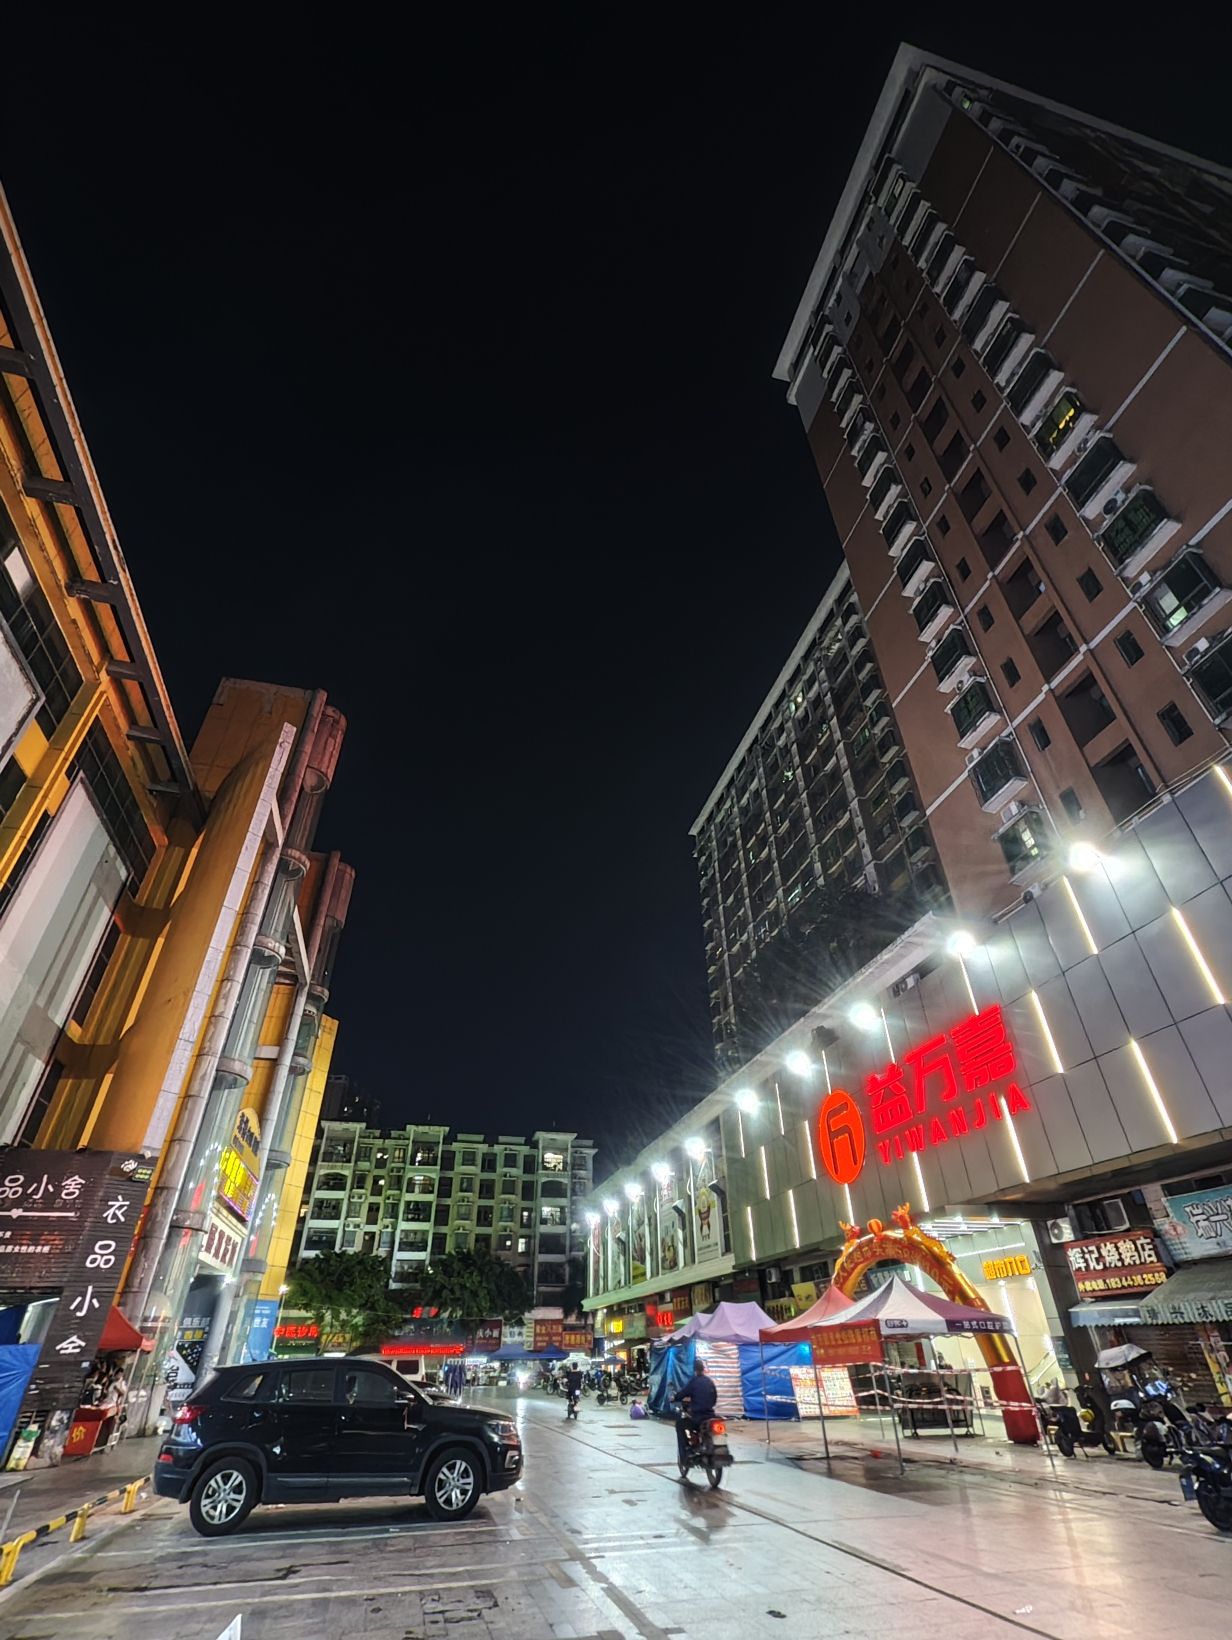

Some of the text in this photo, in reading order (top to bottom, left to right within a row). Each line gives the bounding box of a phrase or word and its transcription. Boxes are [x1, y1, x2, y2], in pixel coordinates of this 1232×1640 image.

[866, 1004, 1015, 1134] 益万嘉
[878, 1083, 1030, 1165] YIWANJIA
[1067, 1236, 1158, 1271] 辉记烧鹅店
